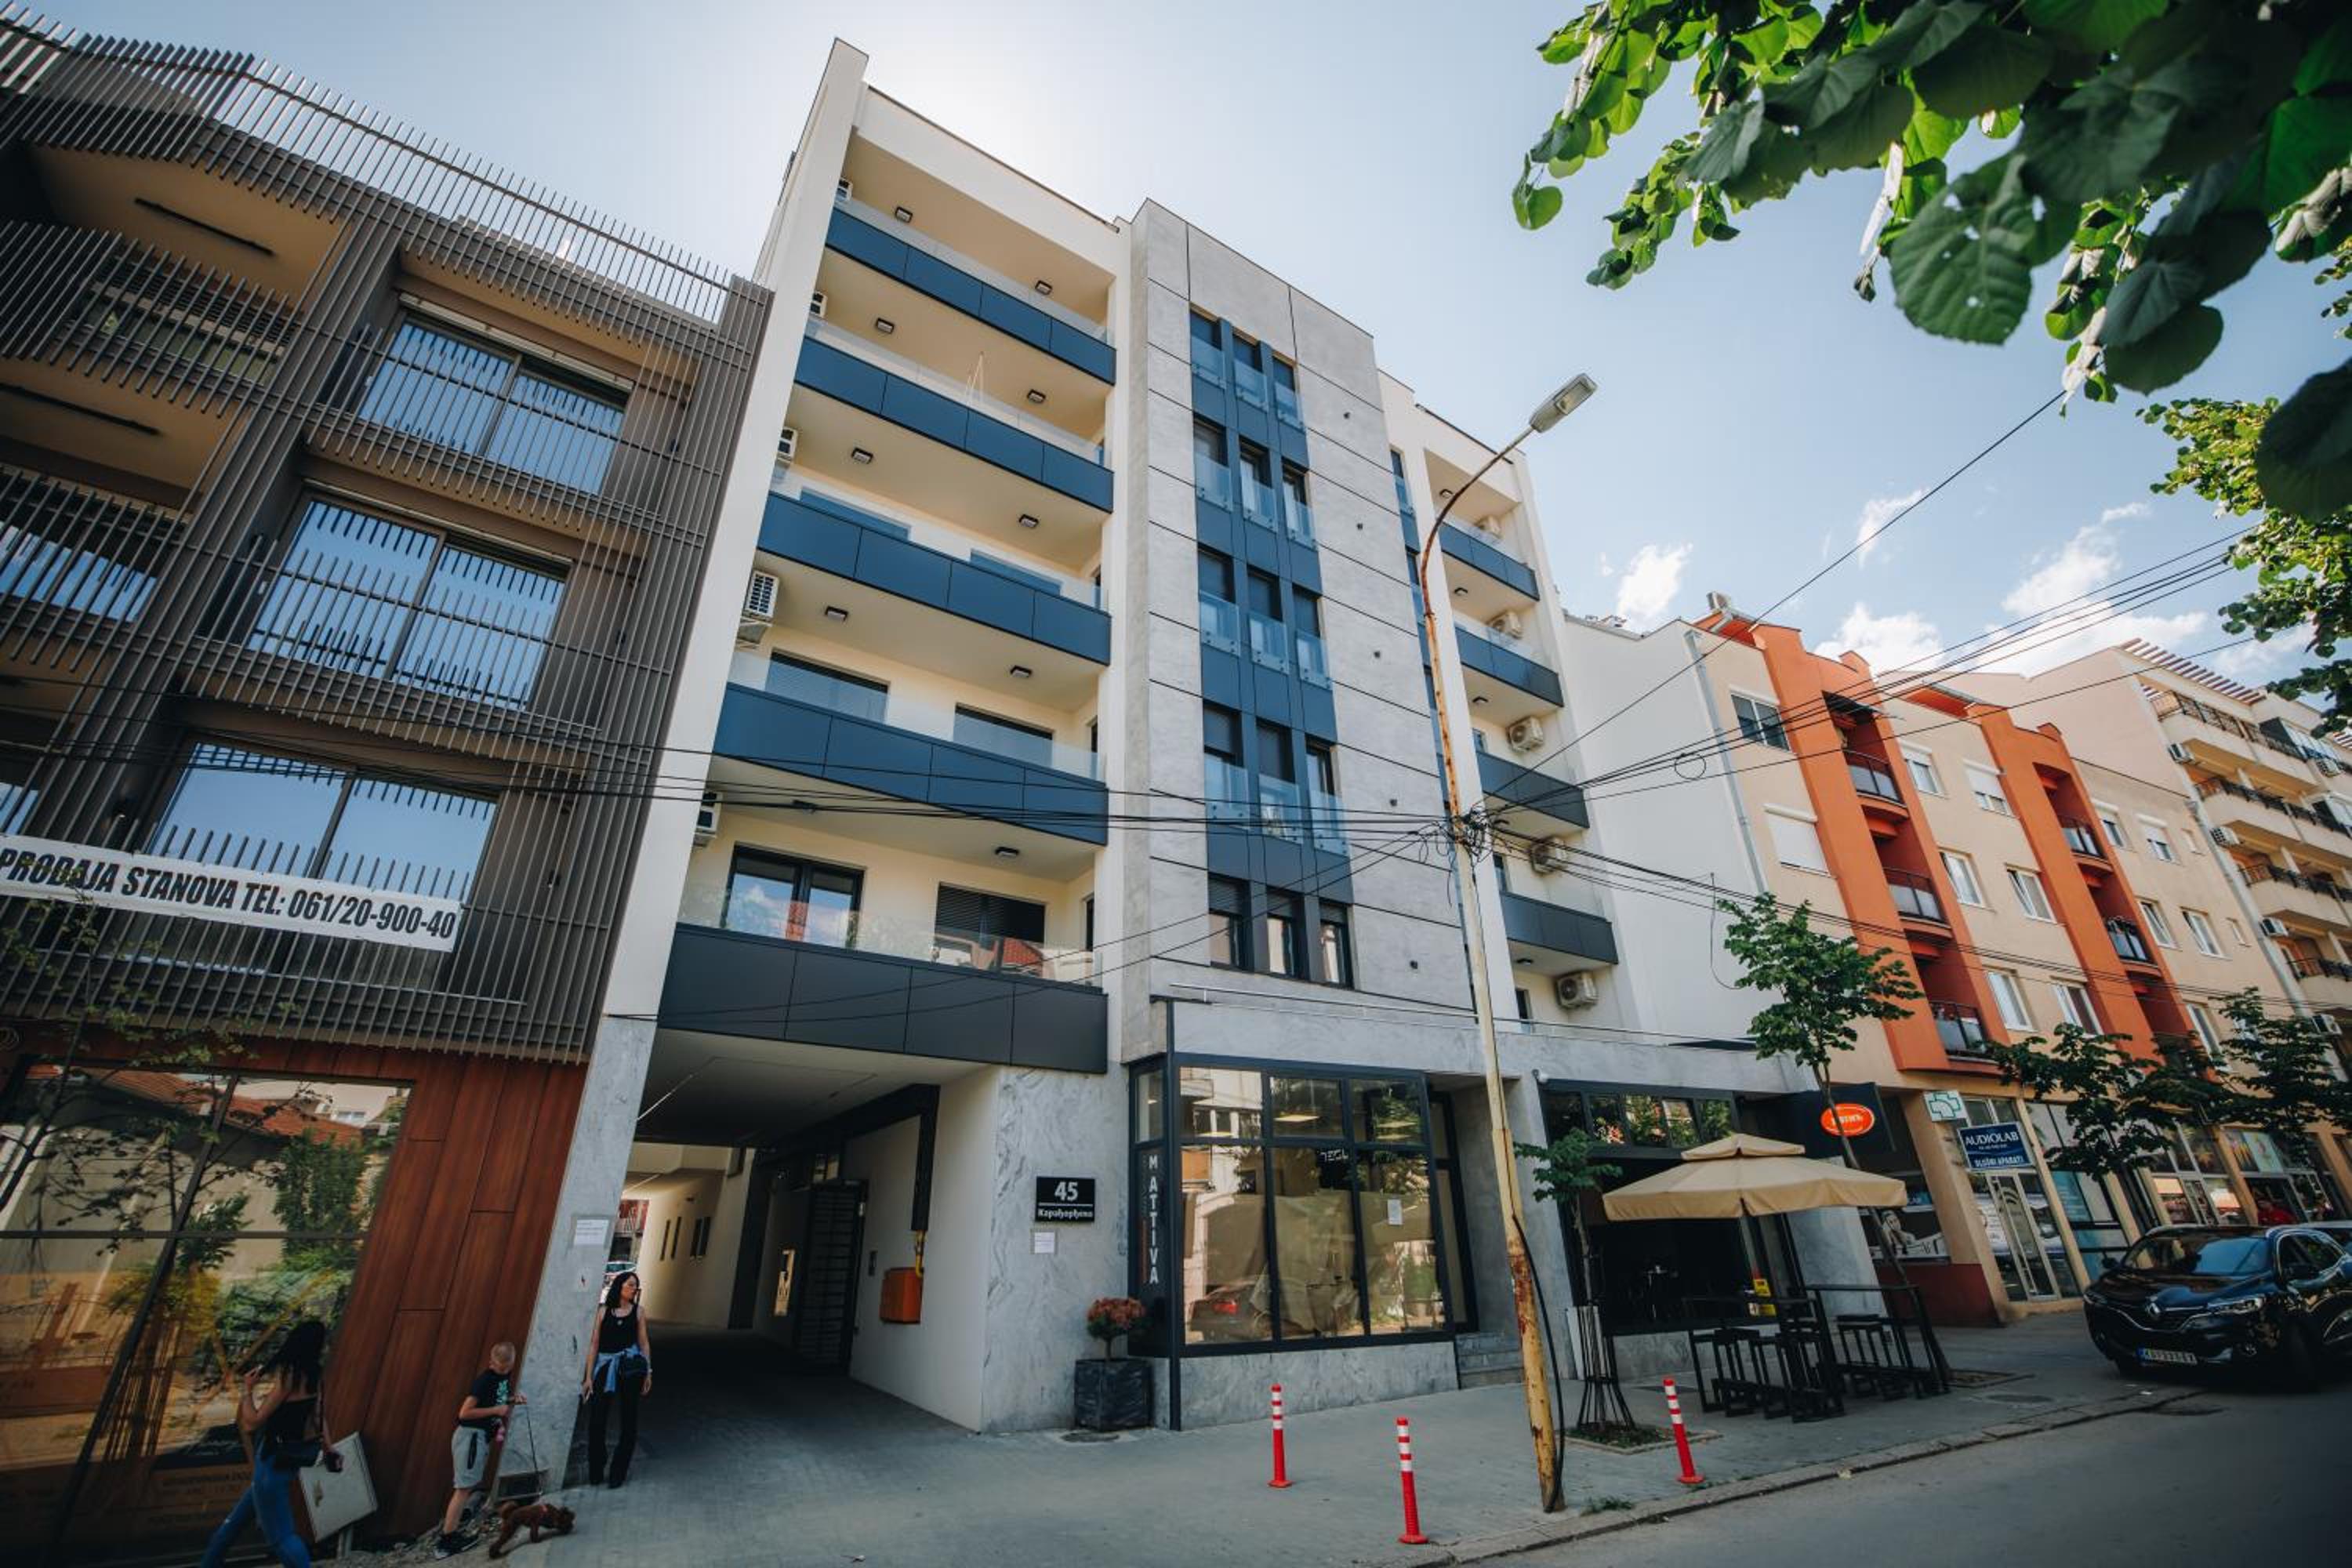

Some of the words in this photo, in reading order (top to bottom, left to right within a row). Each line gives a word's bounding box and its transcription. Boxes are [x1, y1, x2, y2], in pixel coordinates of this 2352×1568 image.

[0, 848, 120, 892] PRODAJA
[122, 866, 238, 908] STANOVA
[239, 882, 285, 916] TEL:
[287, 889, 456, 939] 061/20-900-40
[1965, 1131, 2019, 1145] AUDIOLAB
[1054, 1181, 1078, 1201] 45
